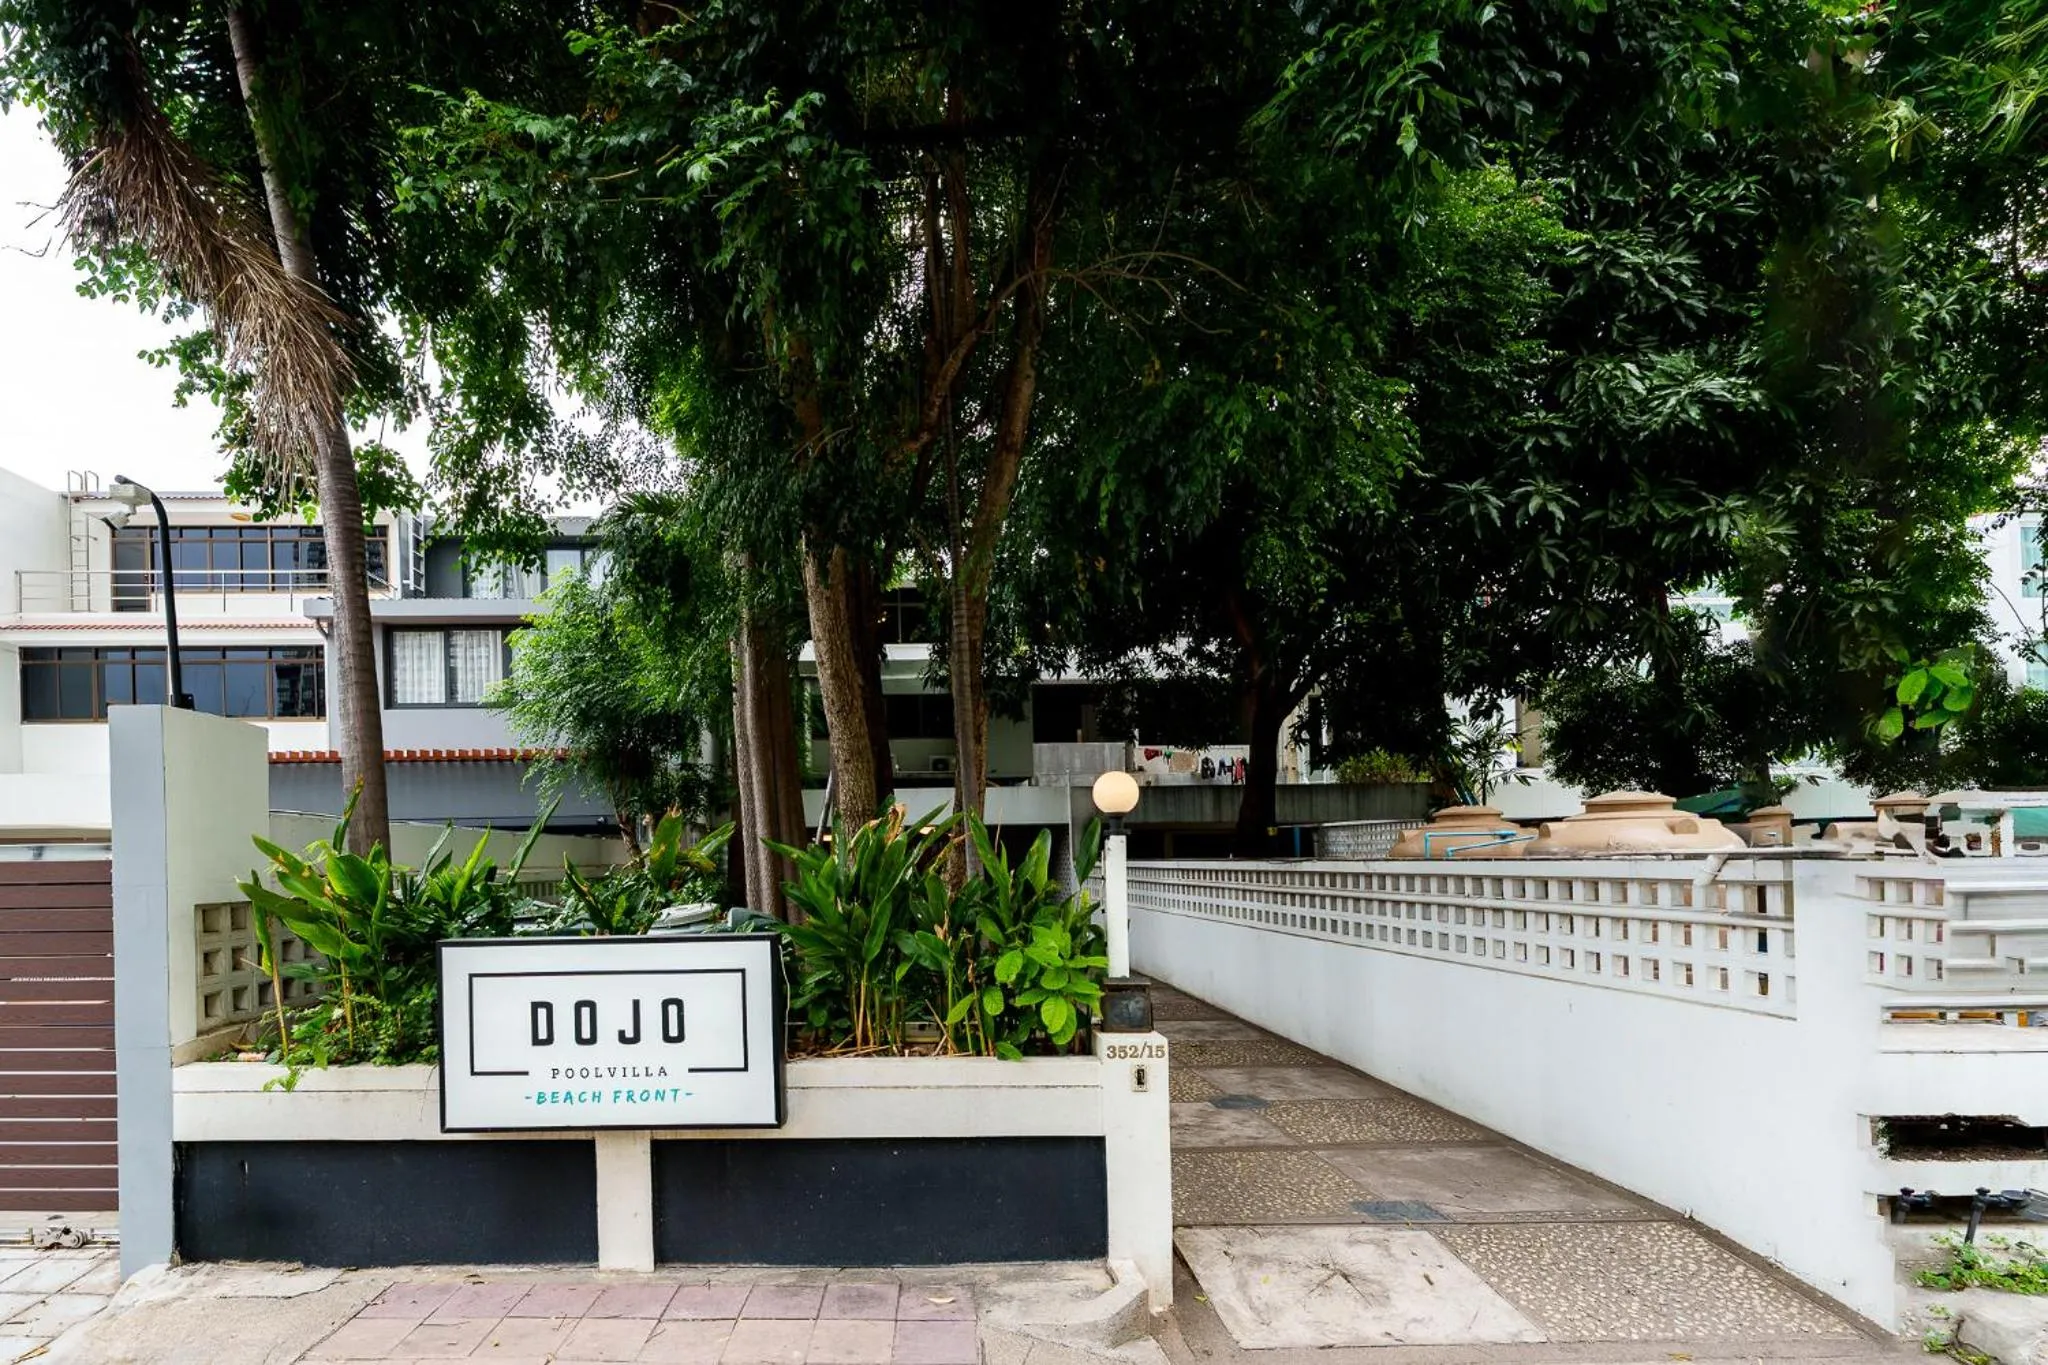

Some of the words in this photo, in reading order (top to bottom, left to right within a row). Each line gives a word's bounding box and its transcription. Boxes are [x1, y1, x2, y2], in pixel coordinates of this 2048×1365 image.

[531, 997, 685, 1047] DOJO
[1106, 1040, 1166, 1060] 352/15
[551, 1066, 668, 1079] POOLVILLA
